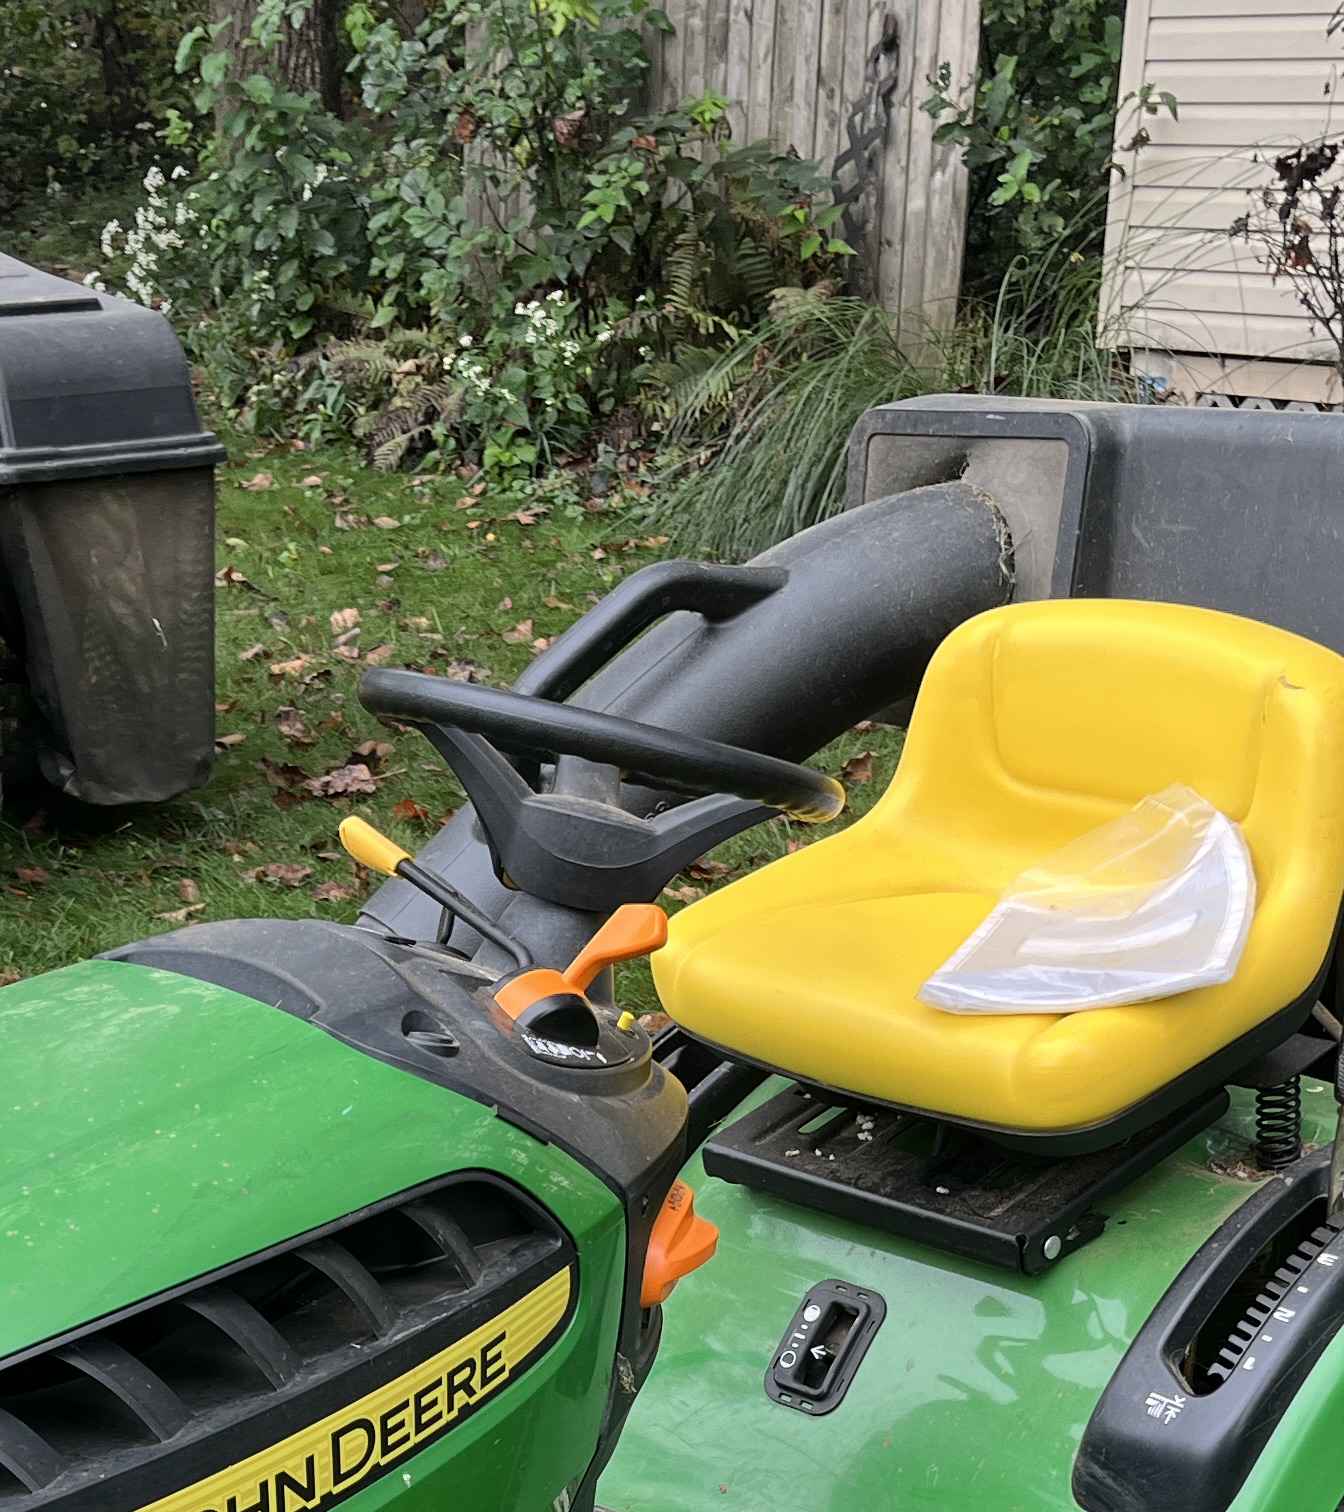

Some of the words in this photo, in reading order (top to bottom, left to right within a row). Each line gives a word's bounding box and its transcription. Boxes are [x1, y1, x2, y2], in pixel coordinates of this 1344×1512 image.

[1316, 1252, 1339, 1267] 3
[1273, 1307, 1295, 1323] 2
[331, 1331, 507, 1487] DEERE
